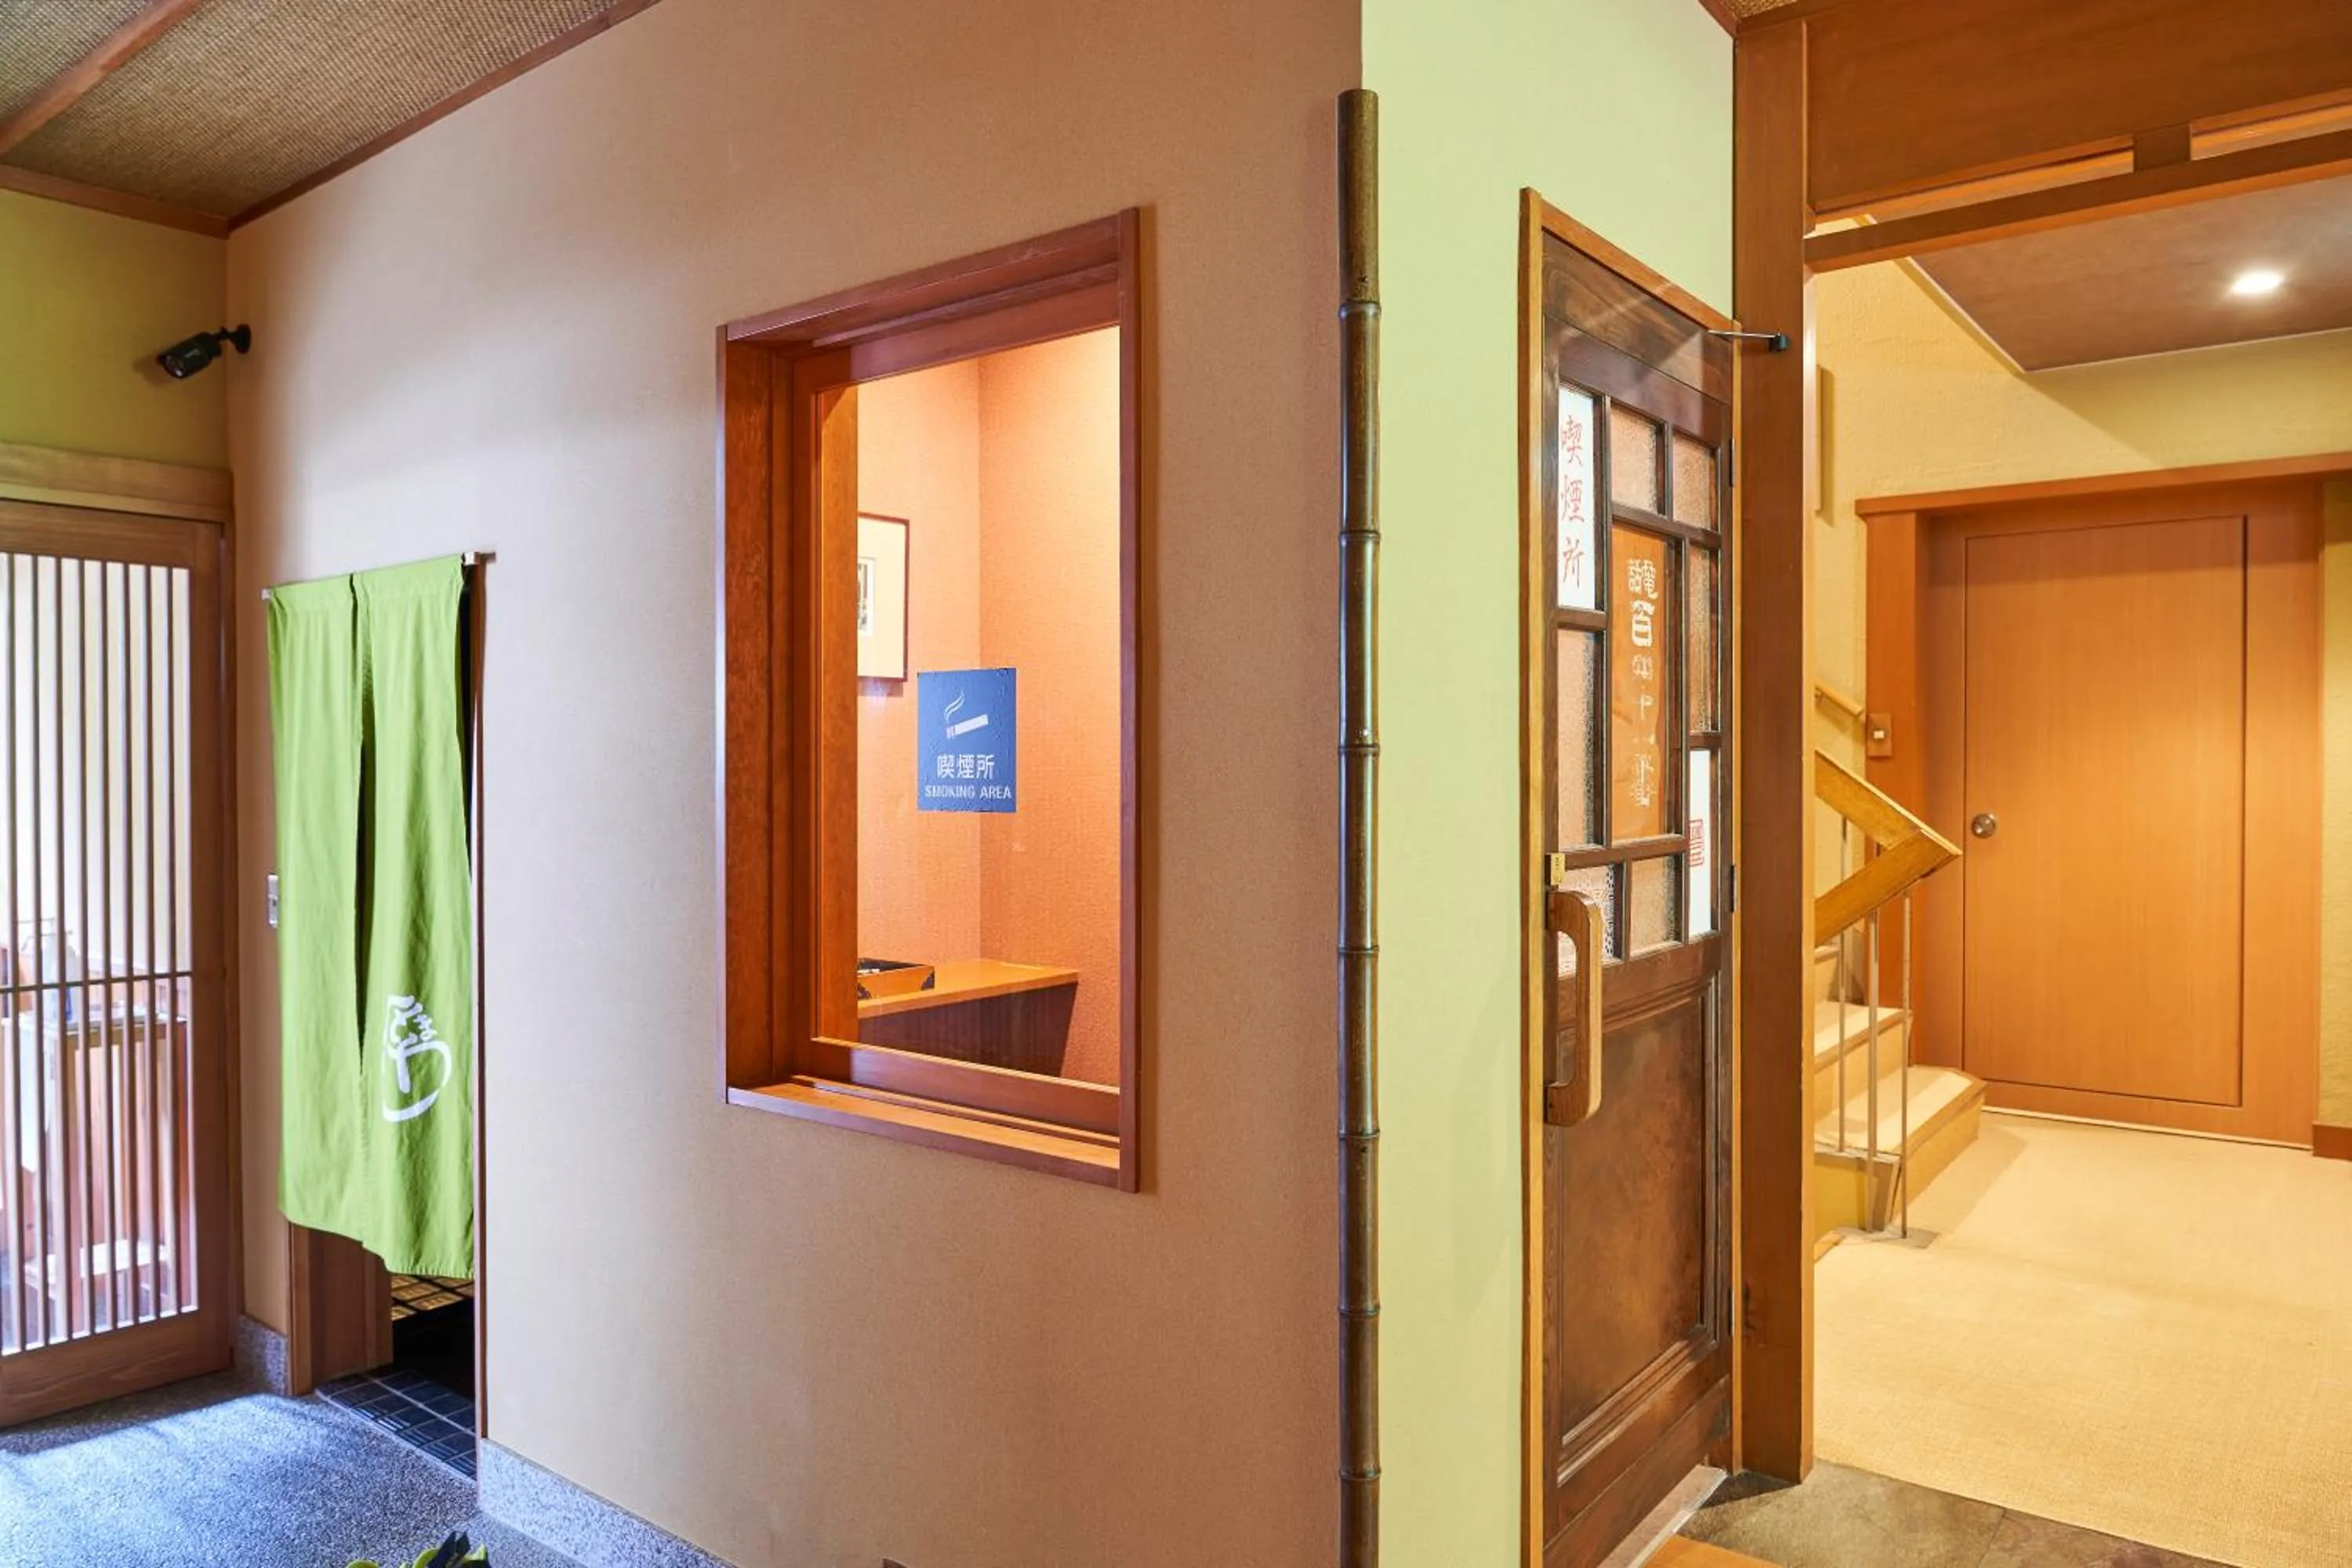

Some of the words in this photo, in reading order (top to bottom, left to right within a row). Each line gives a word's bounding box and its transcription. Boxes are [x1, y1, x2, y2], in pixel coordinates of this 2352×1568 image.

[1560, 414, 1585, 589] 喫煙所
[937, 753, 995, 779] 喫煙所
[925, 785, 975, 800] SMOKING
[980, 785, 1012, 800] AREA
